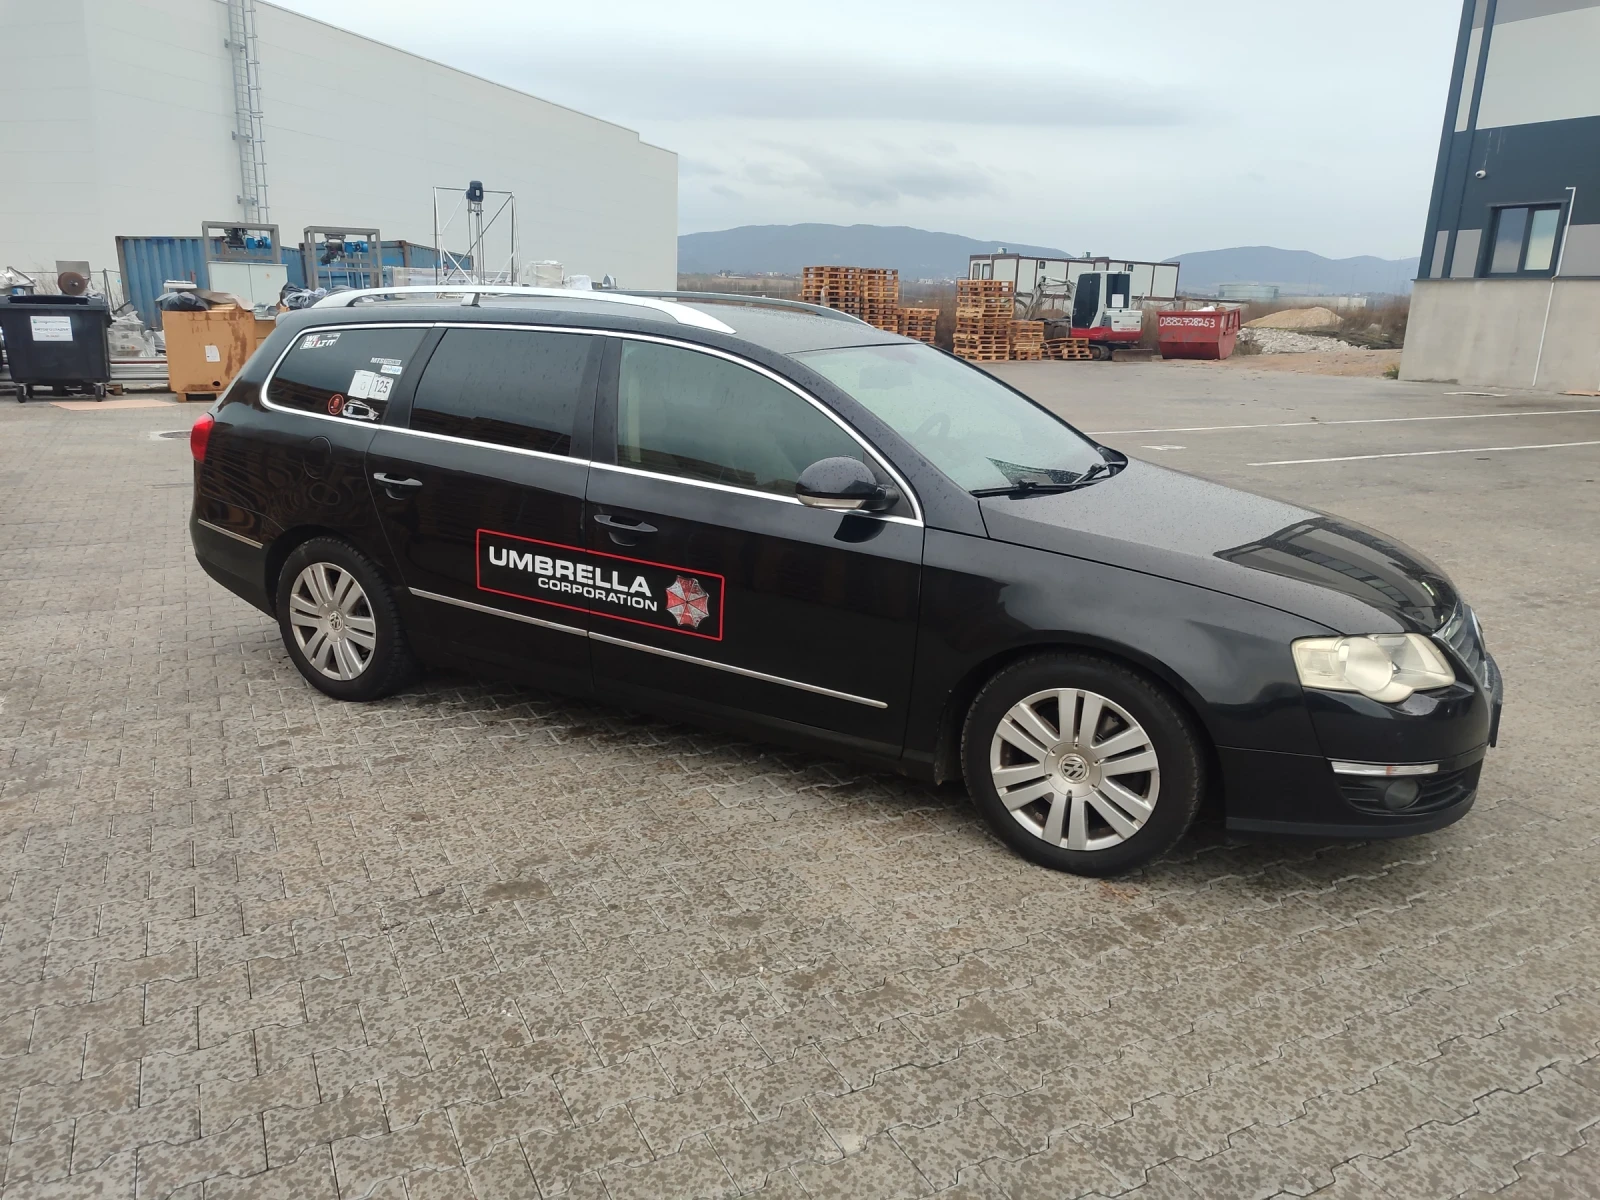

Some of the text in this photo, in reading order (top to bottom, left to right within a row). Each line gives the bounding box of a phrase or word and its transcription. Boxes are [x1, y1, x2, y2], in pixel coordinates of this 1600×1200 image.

[1159, 316, 1216, 328] 0882728253
[374, 379, 390, 394] 125
[489, 545, 653, 597] UMBRELLA
[537, 576, 658, 612] CORPORATION
